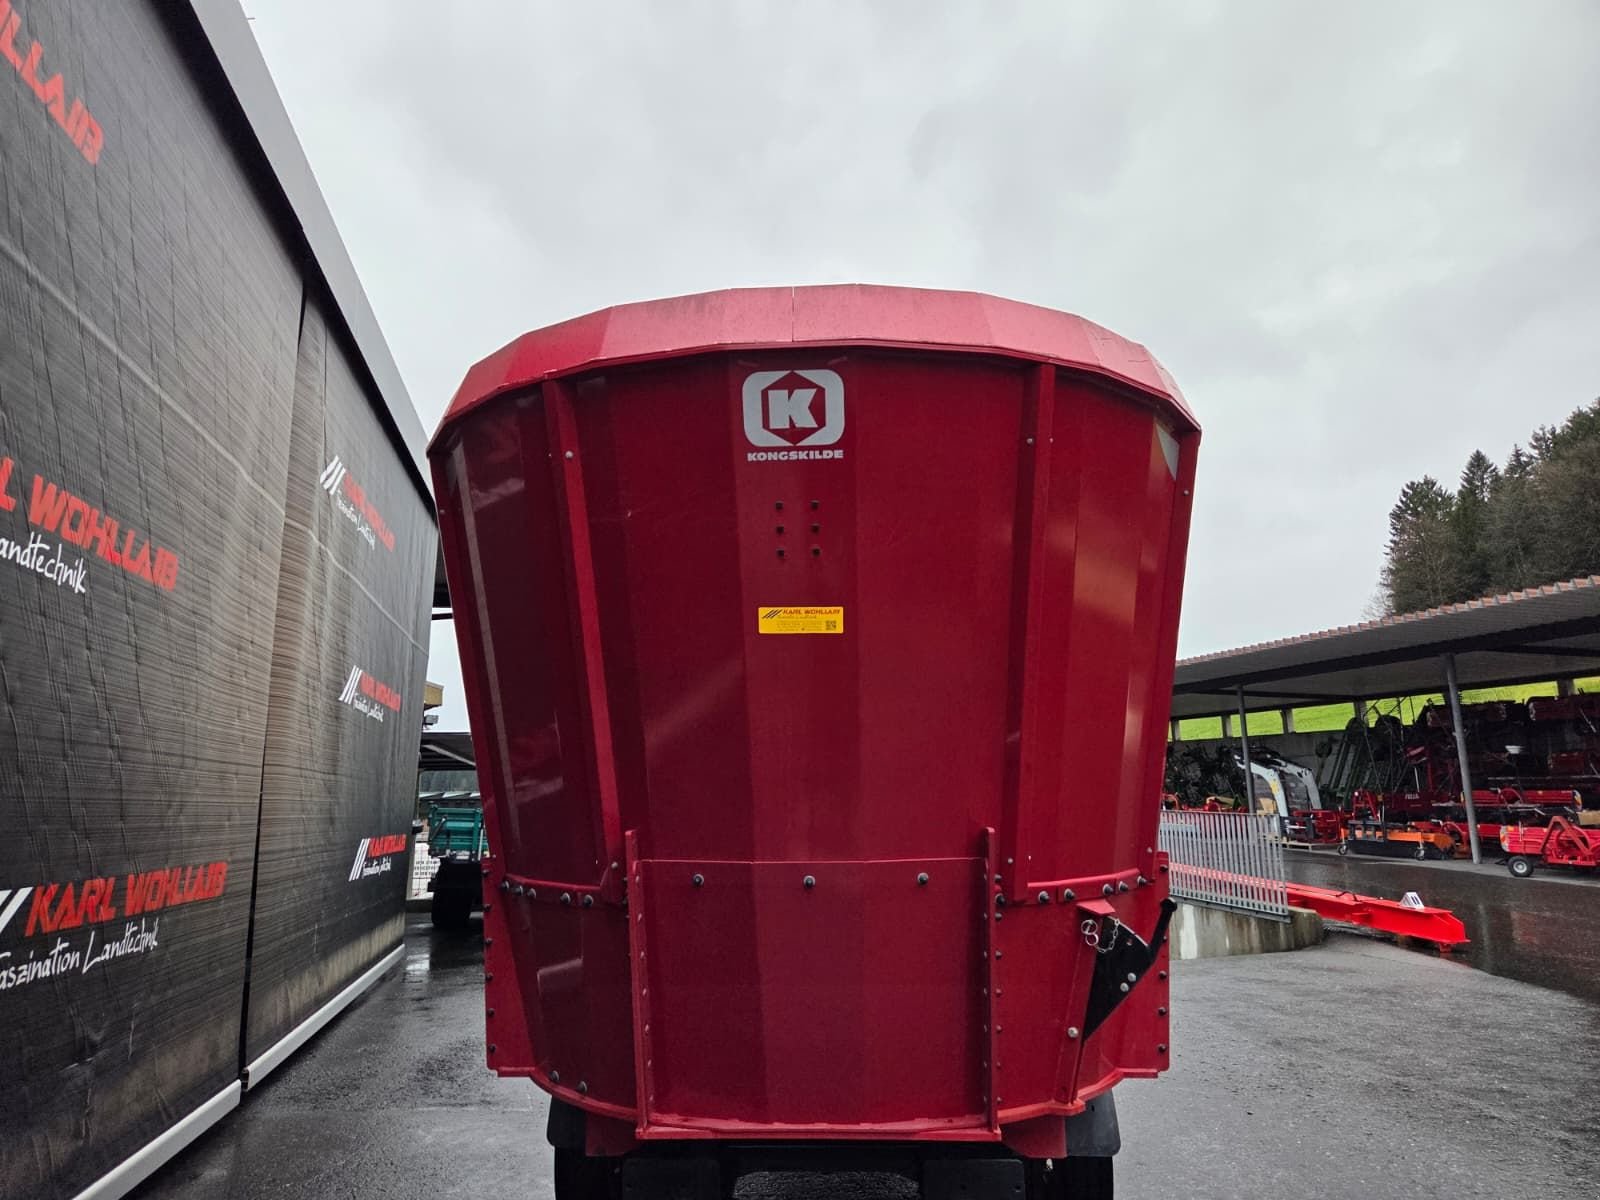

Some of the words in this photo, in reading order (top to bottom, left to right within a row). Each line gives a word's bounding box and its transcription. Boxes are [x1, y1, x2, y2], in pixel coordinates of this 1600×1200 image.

[768, 388, 819, 430] K
[747, 449, 844, 462] KONGSKILDE
[29, 473, 179, 593] WOHLLAIB
[25, 877, 117, 937] KARL
[124, 861, 228, 917] WOHLLAIB
